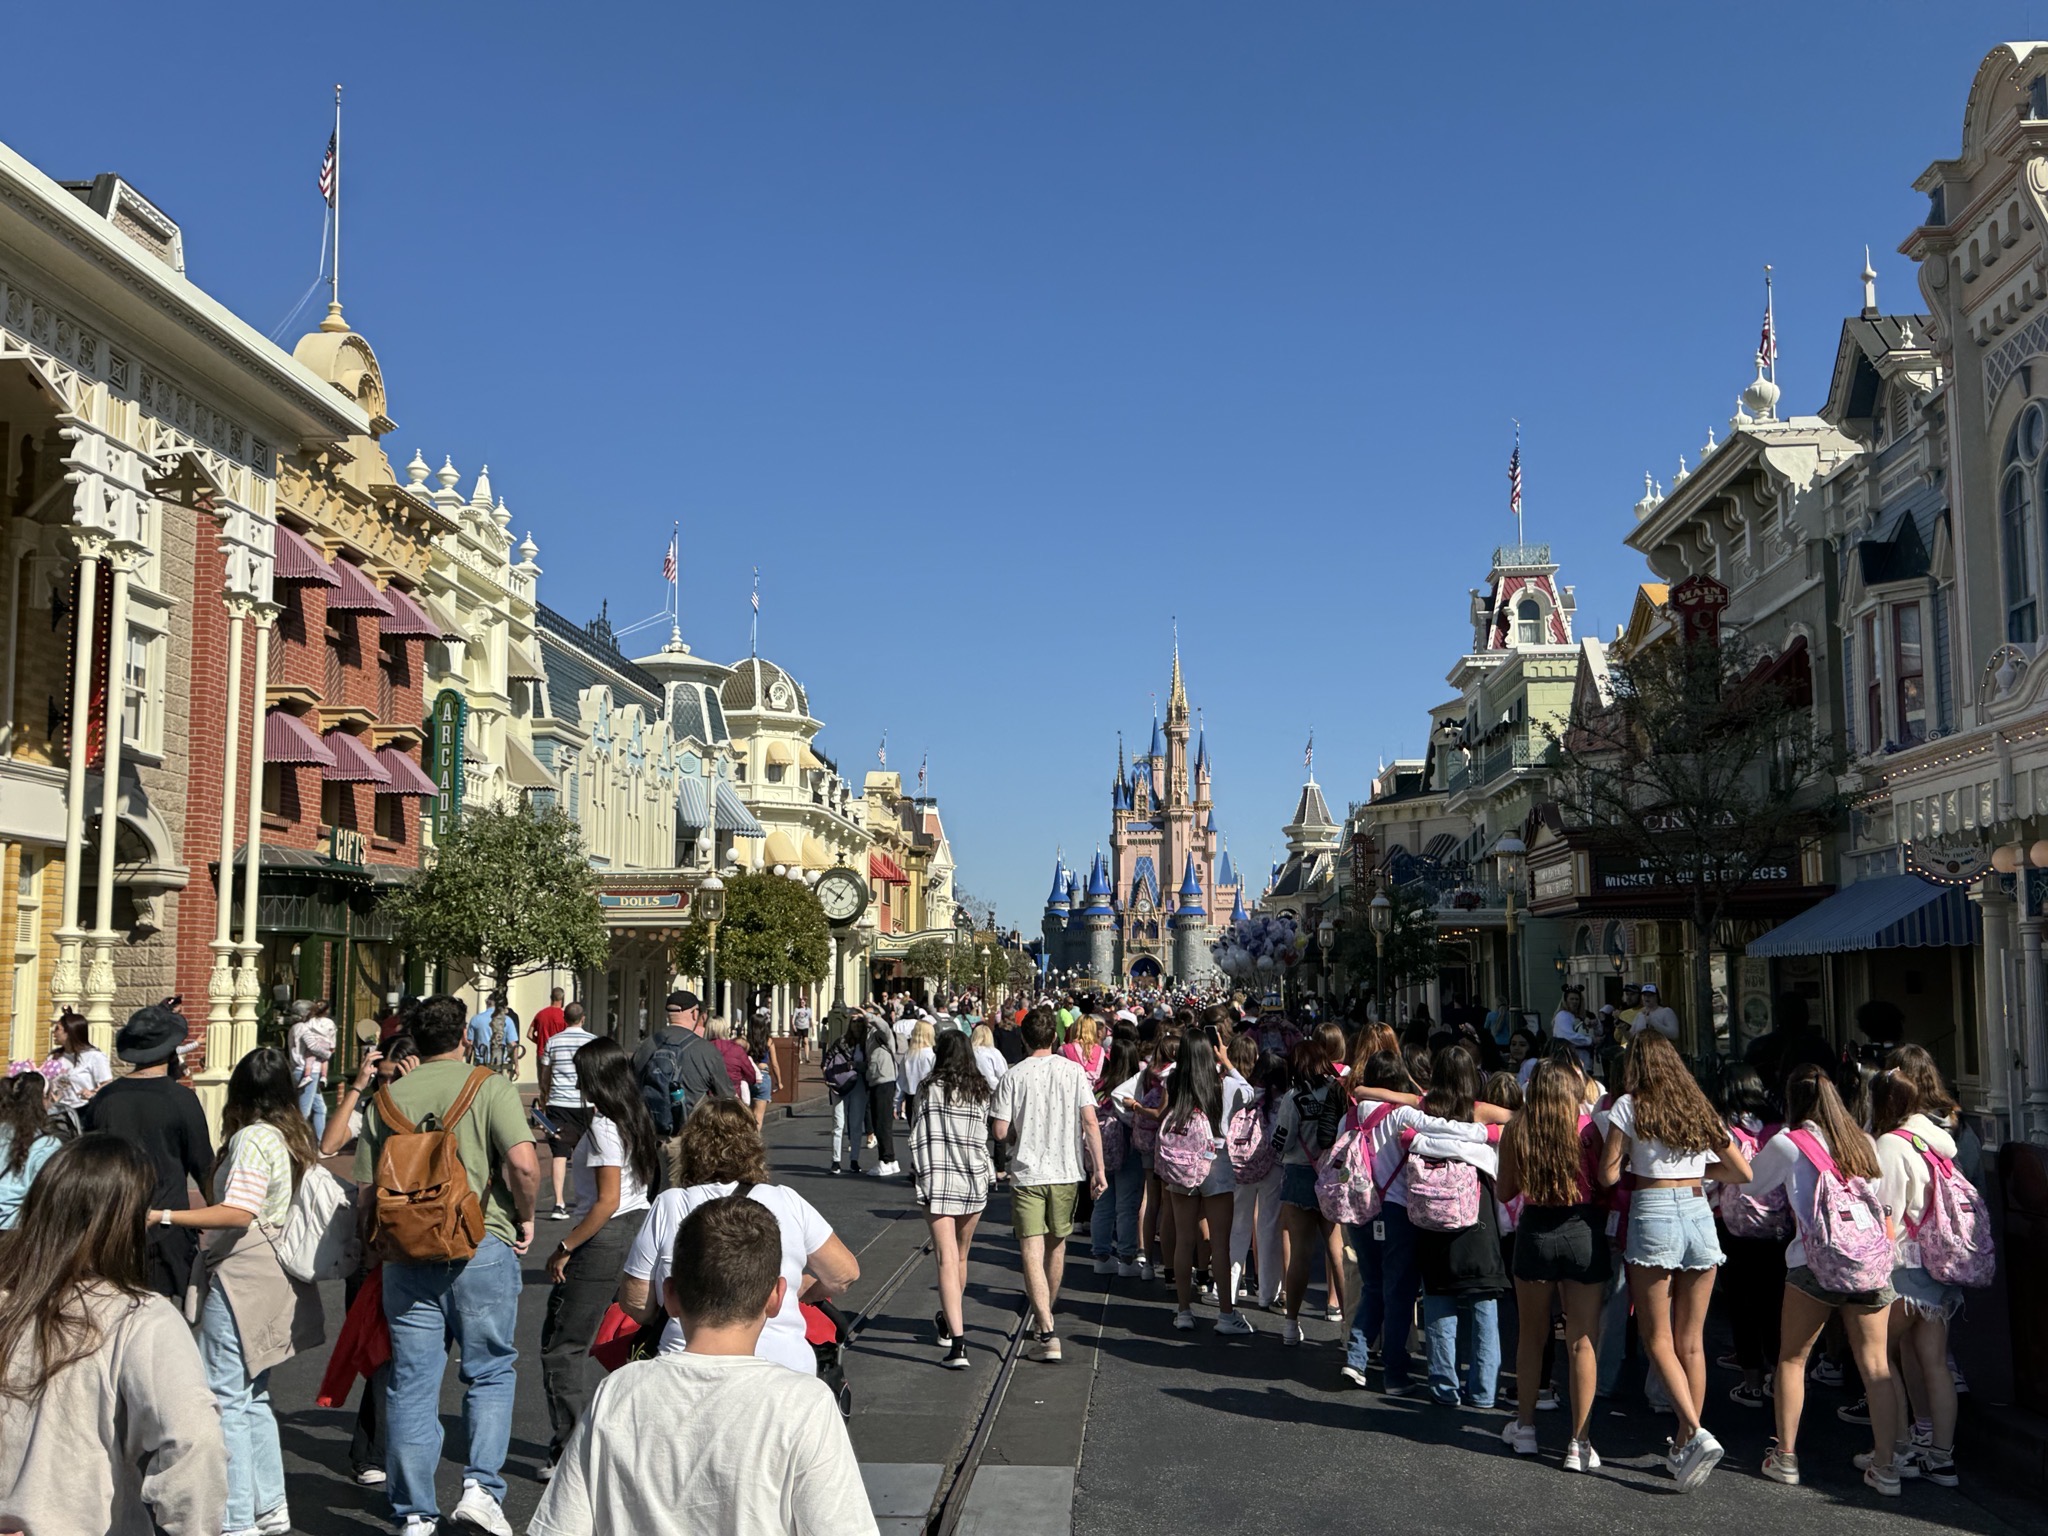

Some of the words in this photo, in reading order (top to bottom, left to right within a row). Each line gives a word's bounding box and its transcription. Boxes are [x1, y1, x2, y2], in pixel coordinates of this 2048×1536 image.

[1678, 586, 1720, 602] MAIN
[438, 702, 452, 835] ARCADE
[336, 828, 367, 864] GIFTS
[1605, 872, 1655, 887] MICKEY
[619, 896, 661, 906] DOLLS
